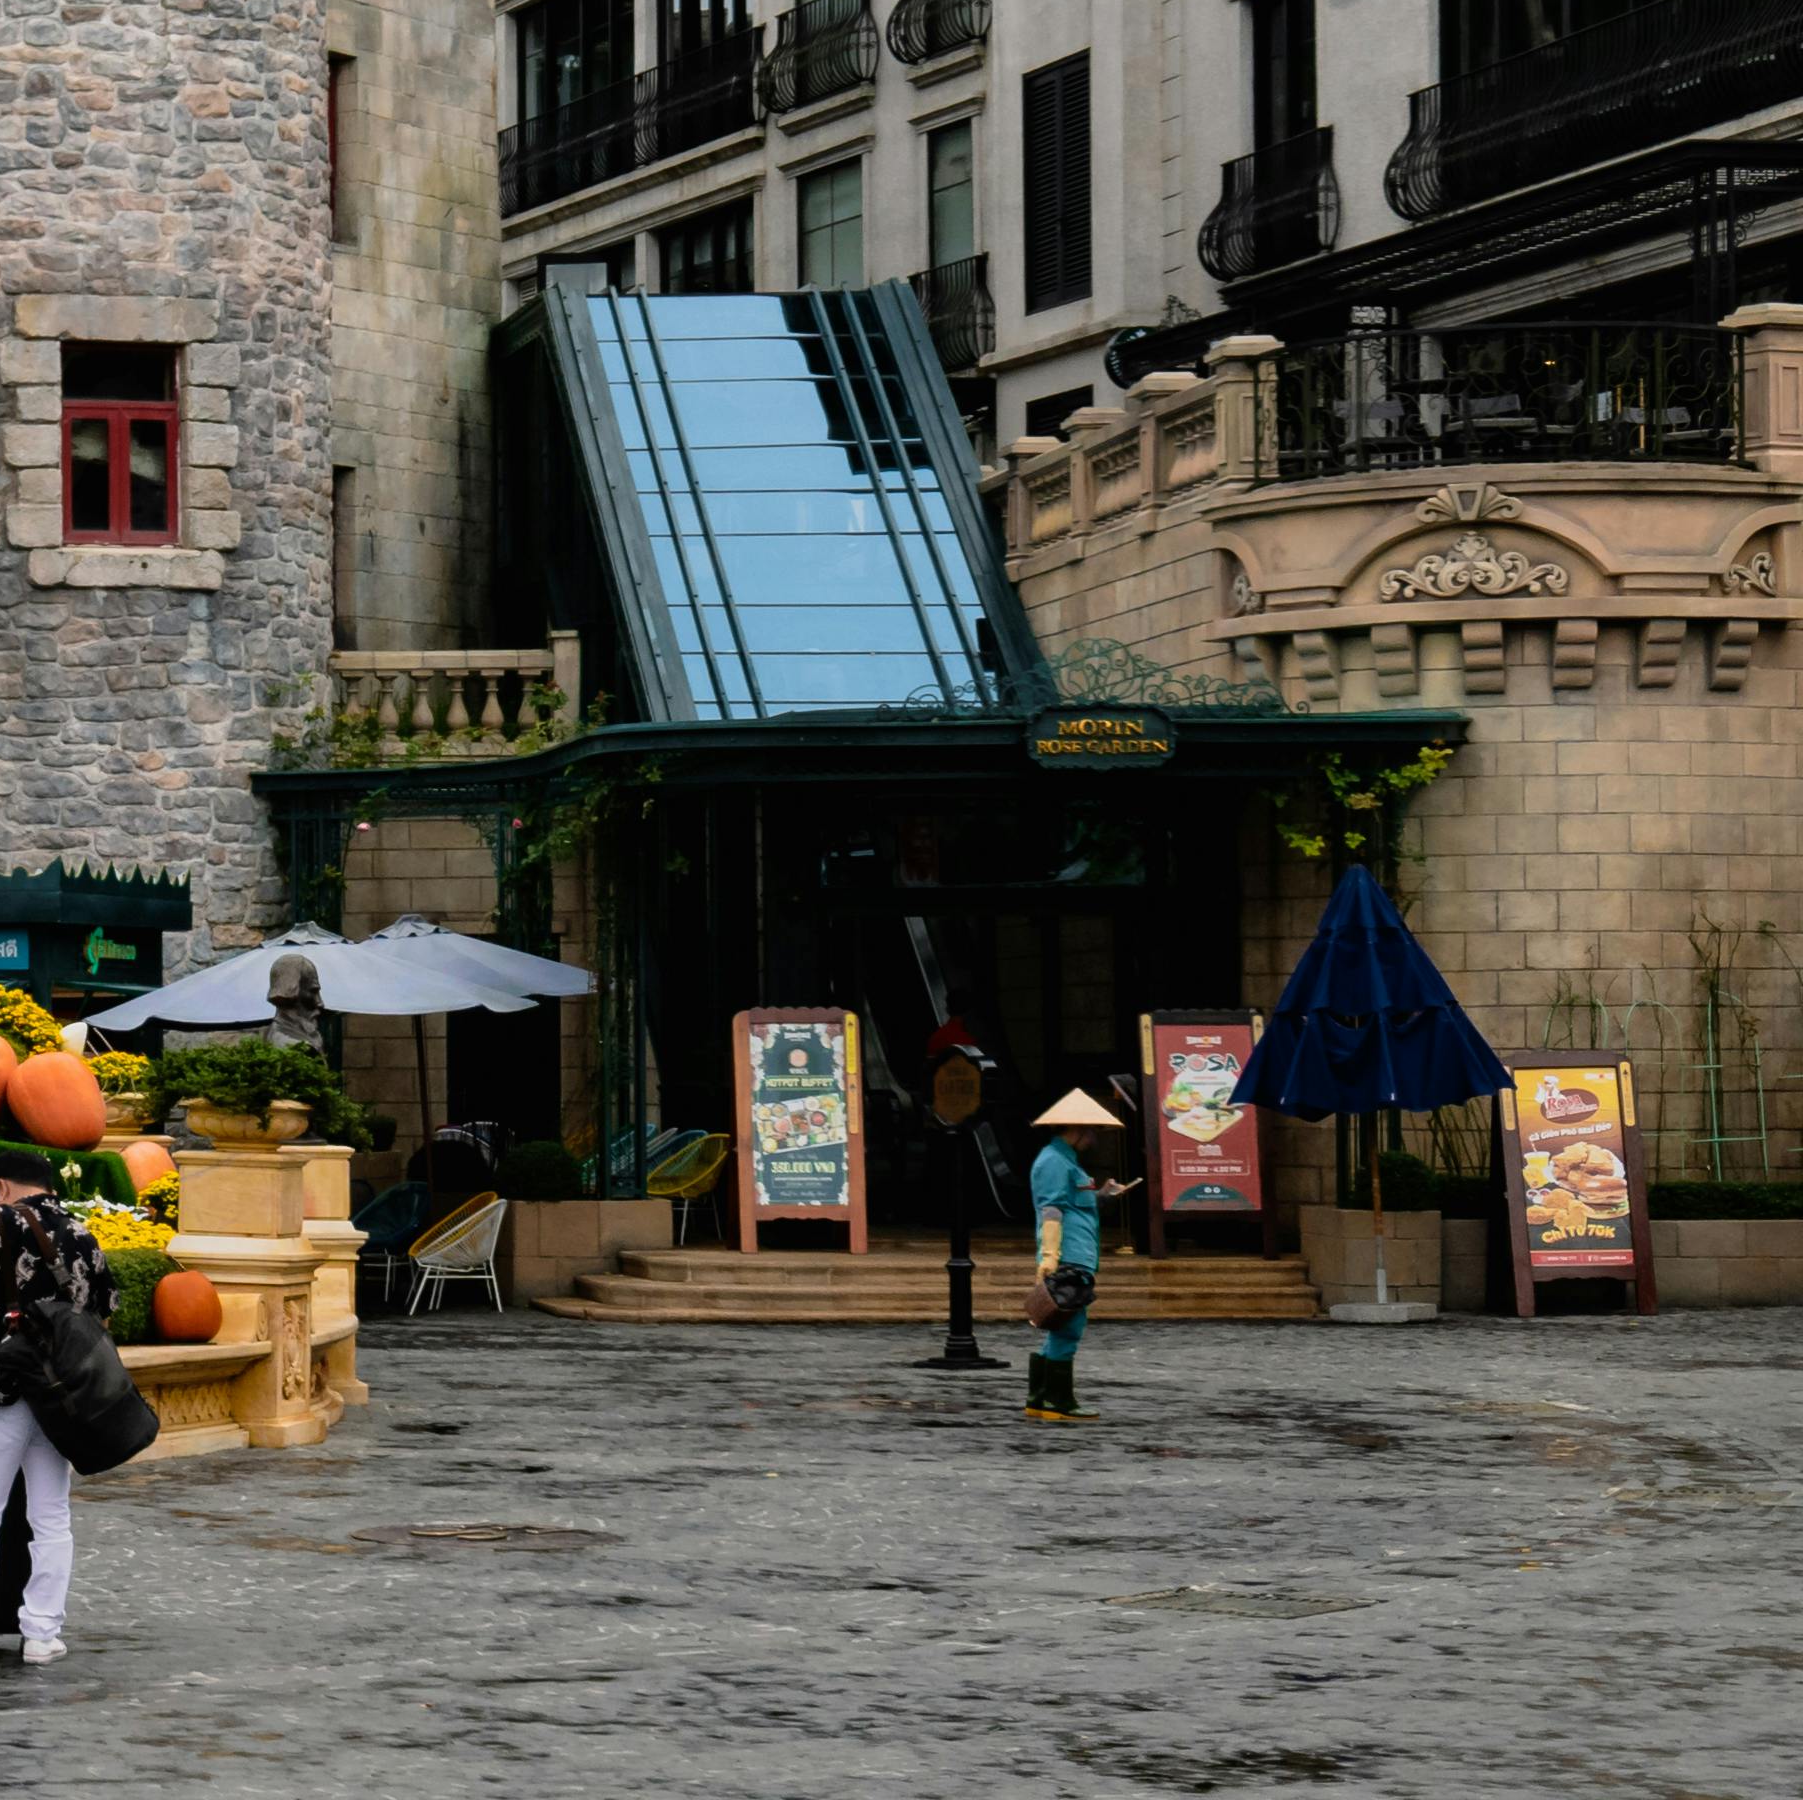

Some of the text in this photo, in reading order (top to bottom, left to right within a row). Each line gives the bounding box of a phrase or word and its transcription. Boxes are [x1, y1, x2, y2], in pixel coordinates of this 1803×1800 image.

[1057, 717, 1144, 736] MORIN
[1035, 738, 1169, 754] ROSE GARDEN
[1169, 1052, 1242, 1073] ROSA
